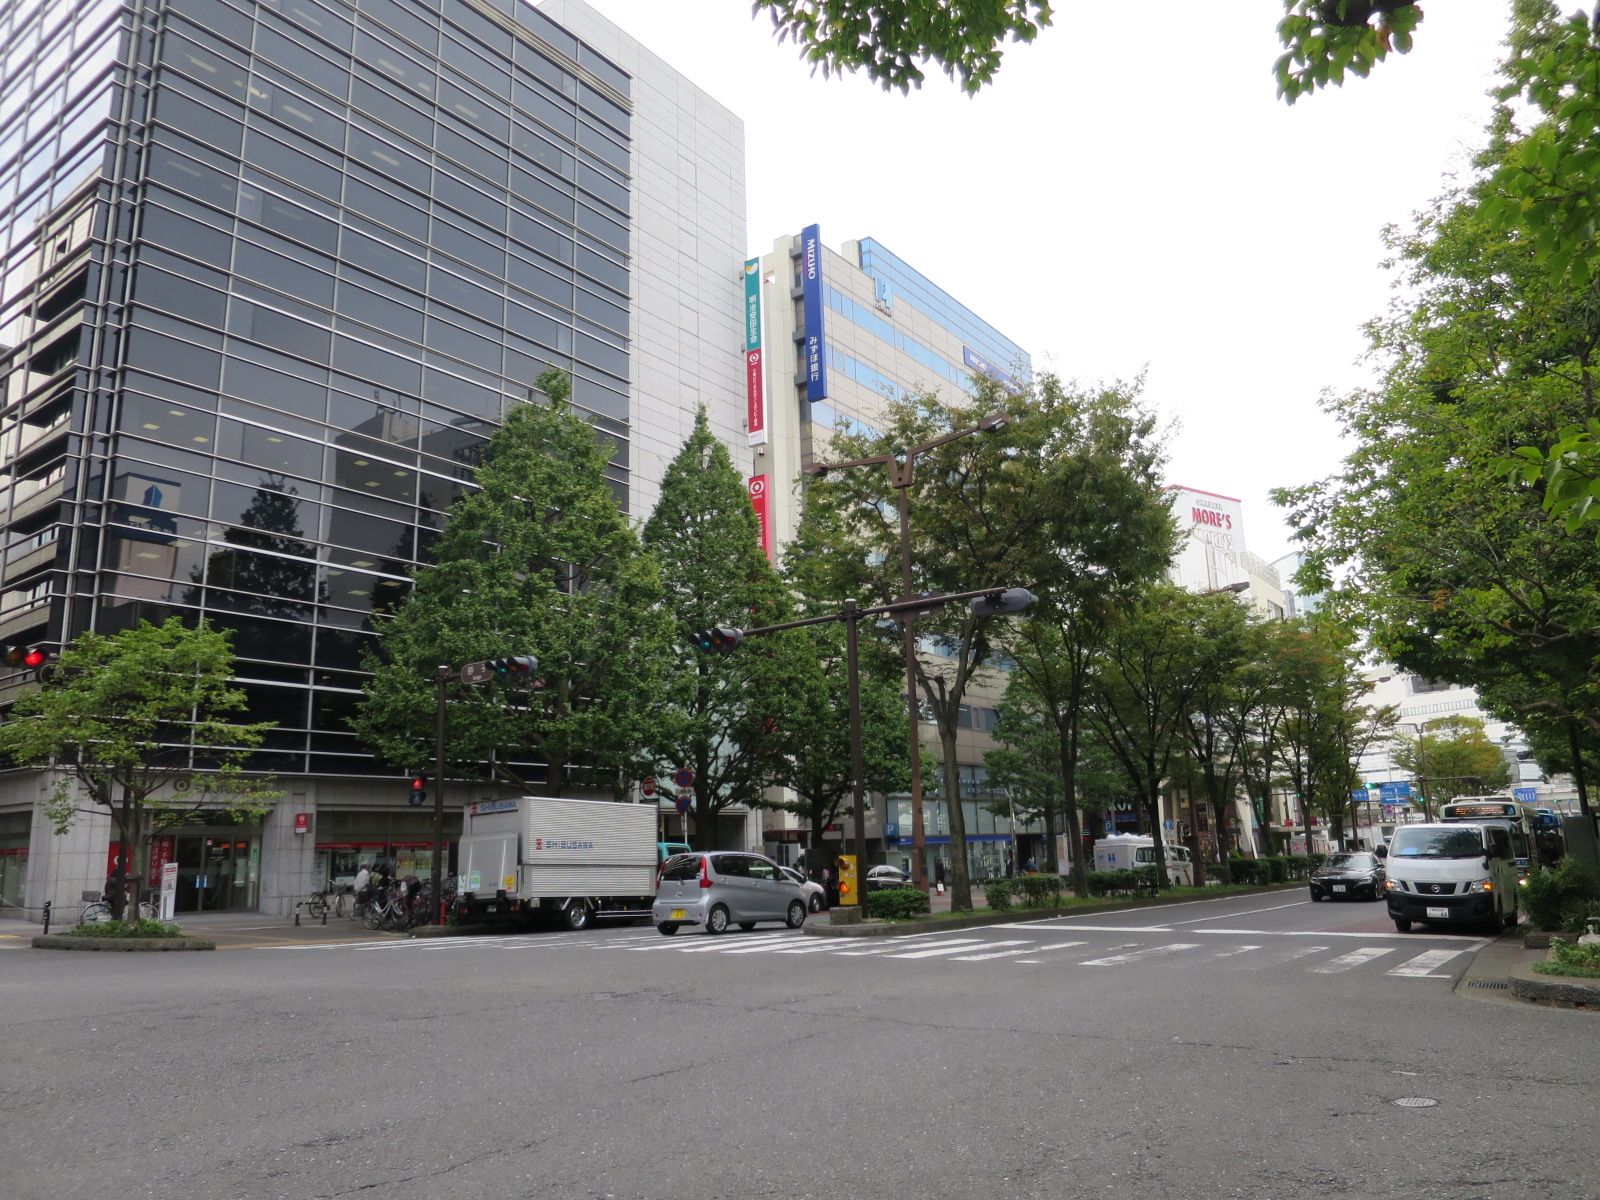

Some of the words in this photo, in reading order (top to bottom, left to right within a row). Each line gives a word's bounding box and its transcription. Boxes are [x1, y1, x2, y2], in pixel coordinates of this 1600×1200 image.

[807, 238, 815, 280] MIZUHO
[809, 336, 819, 382] みずほ銀行
[1191, 507, 1232, 529] MORE'S
[545, 840, 594, 850] SHIBUSAWA
